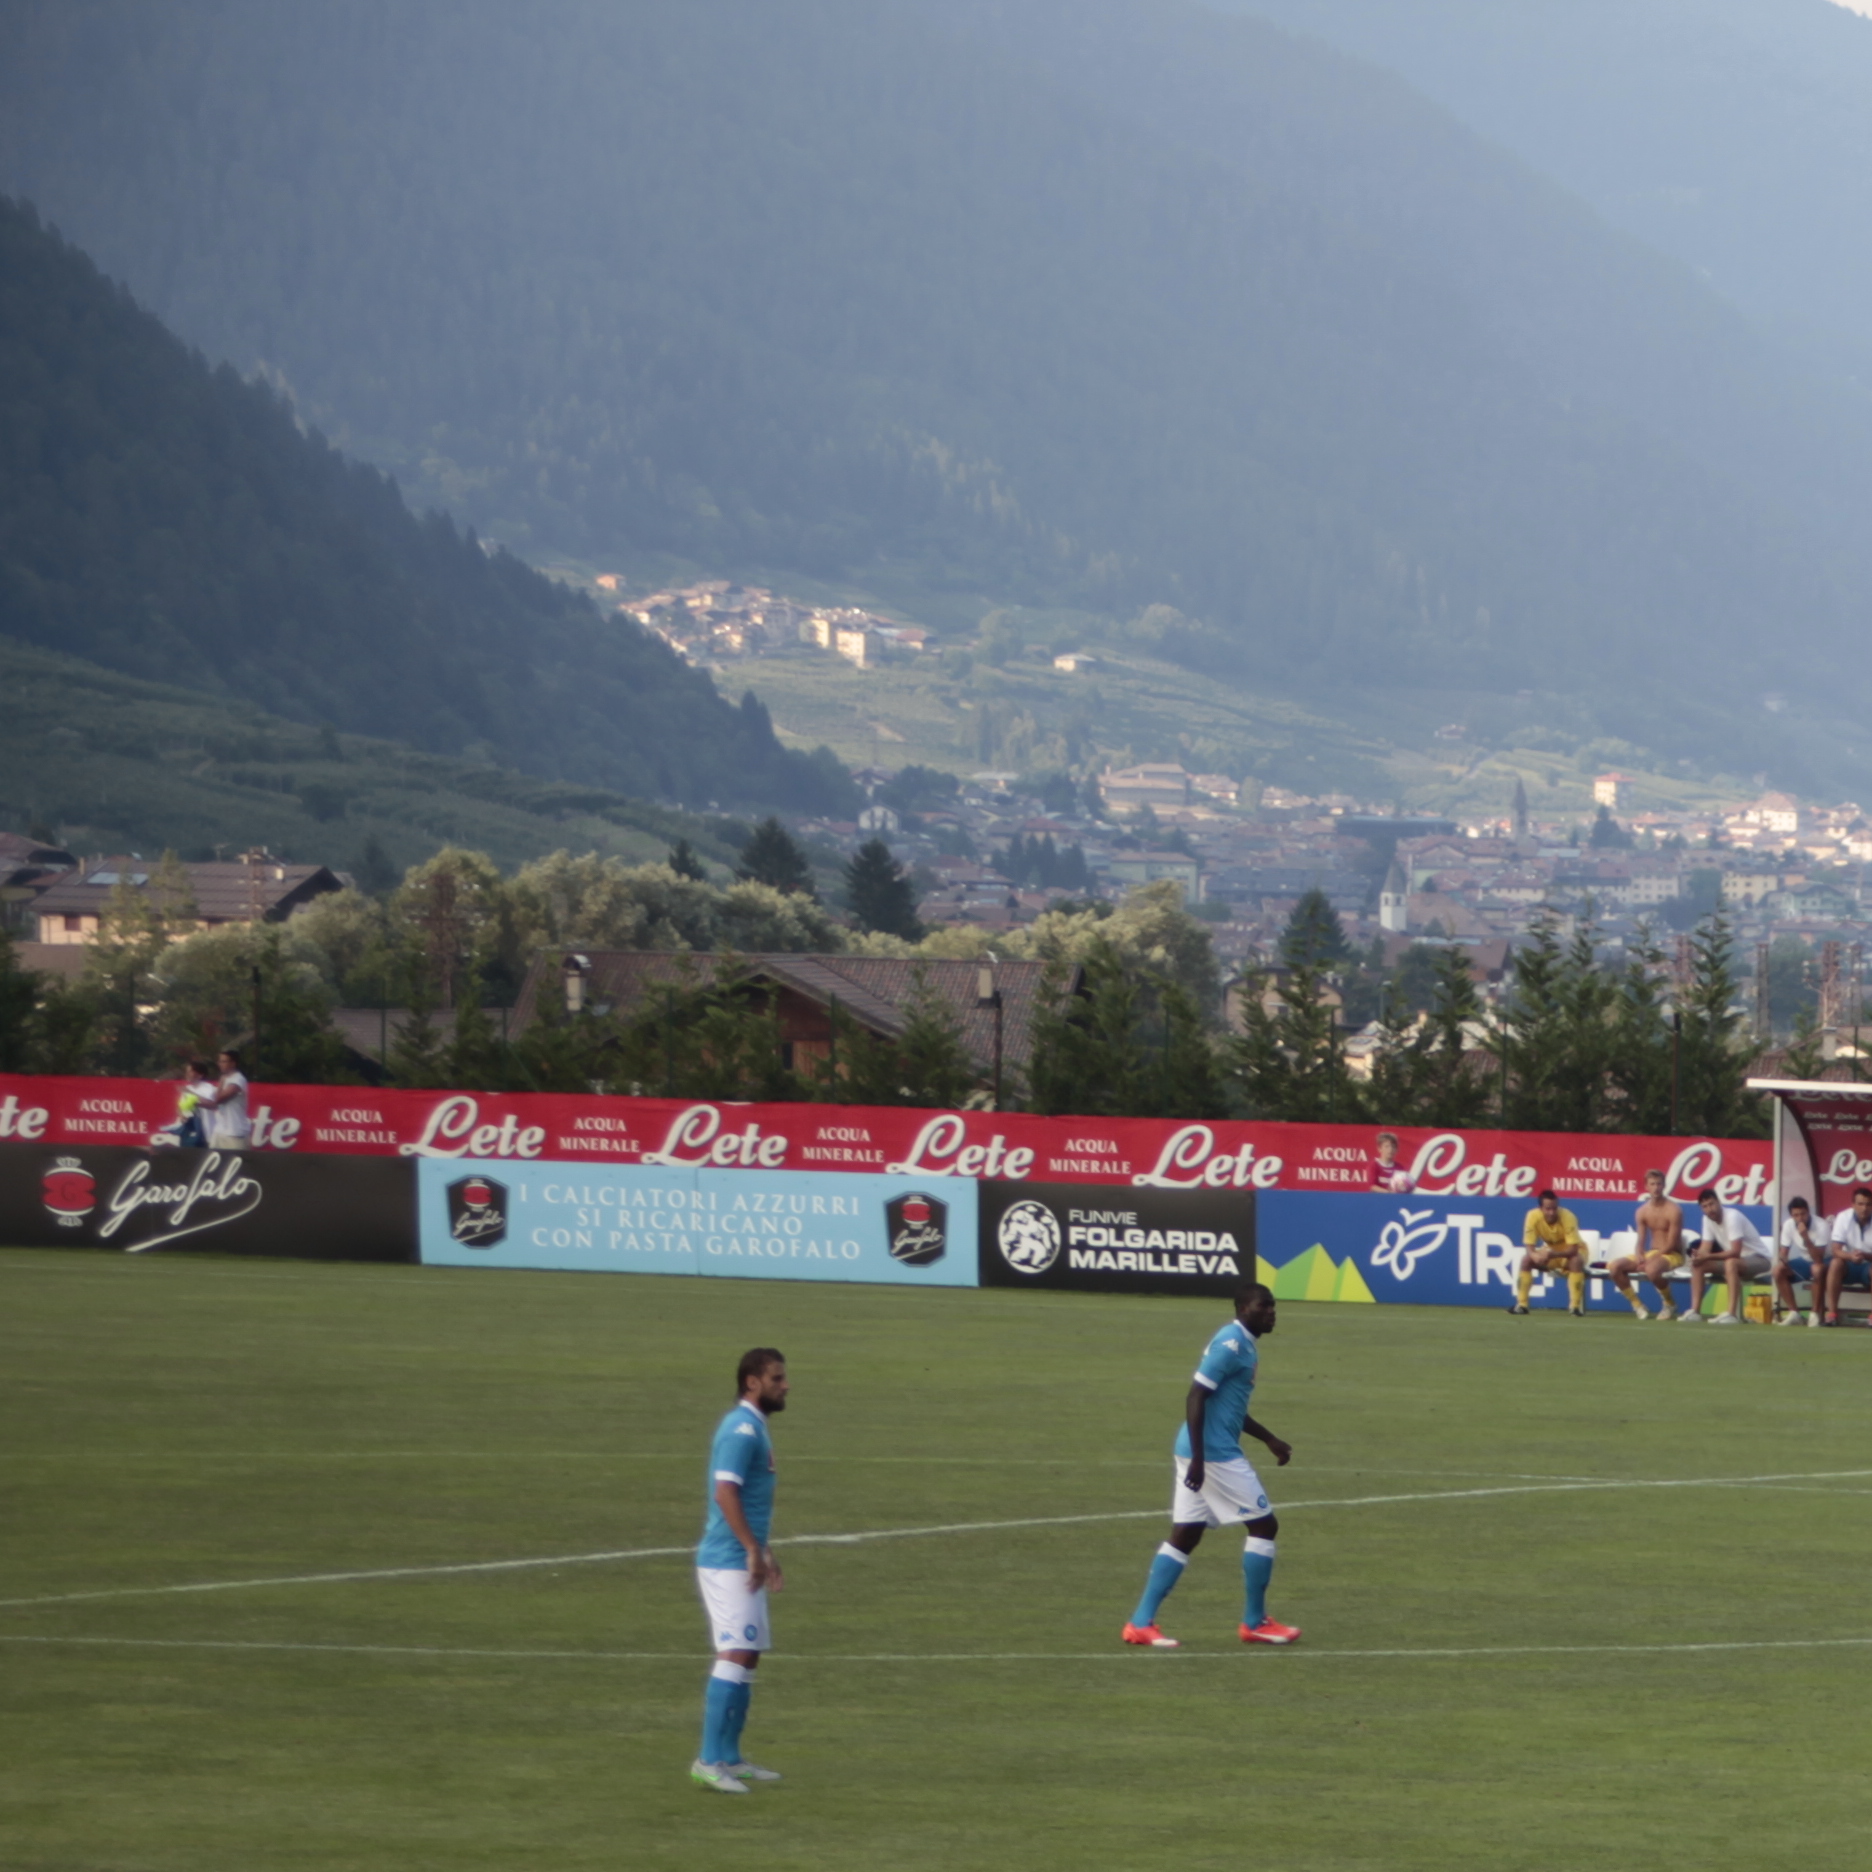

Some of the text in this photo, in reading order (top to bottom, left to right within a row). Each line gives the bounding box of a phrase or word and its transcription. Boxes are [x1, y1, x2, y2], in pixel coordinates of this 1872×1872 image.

[80, 1098, 134, 1114] ACQUA
[0, 1095, 49, 1141] te
[330, 1108, 383, 1124] ACQUA
[573, 1117, 627, 1133] ACQUA
[65, 1118, 149, 1134] MINERALE
[399, 1095, 546, 1159] Lete
[816, 1126, 871, 1142] ACQUA
[315, 1128, 398, 1145] MINERALE
[559, 1136, 641, 1153] MINERALE
[641, 1103, 789, 1168] Lete
[802, 1146, 885, 1164] MINERALE
[884, 1114, 1035, 1179] Lete
[1064, 1138, 1119, 1154] ACQUA
[1312, 1146, 1368, 1162] ACQUA
[1131, 1124, 1283, 1189] Lete
[1408, 1133, 1538, 1198] Lete
[1567, 1156, 1624, 1173] ACQUA
[1049, 1158, 1132, 1175] MINERALE
[1297, 1166, 1369, 1183] MINERA
[1637, 1141, 1774, 1207] Let
[1551, 1176, 1638, 1194] MINERALE
[100, 1151, 262, 1252] Garofalo
[520, 1184, 861, 1217] I CALCIATORI AZZURRI
[577, 1208, 803, 1236] SI RICARICANO
[1067, 1208, 1139, 1226] FUNIVIE
[531, 1228, 862, 1260] CON PASTA GAROFALO
[1067, 1227, 1241, 1252] FOLGARIDA
[1067, 1249, 1241, 1276] MARILLEVA
